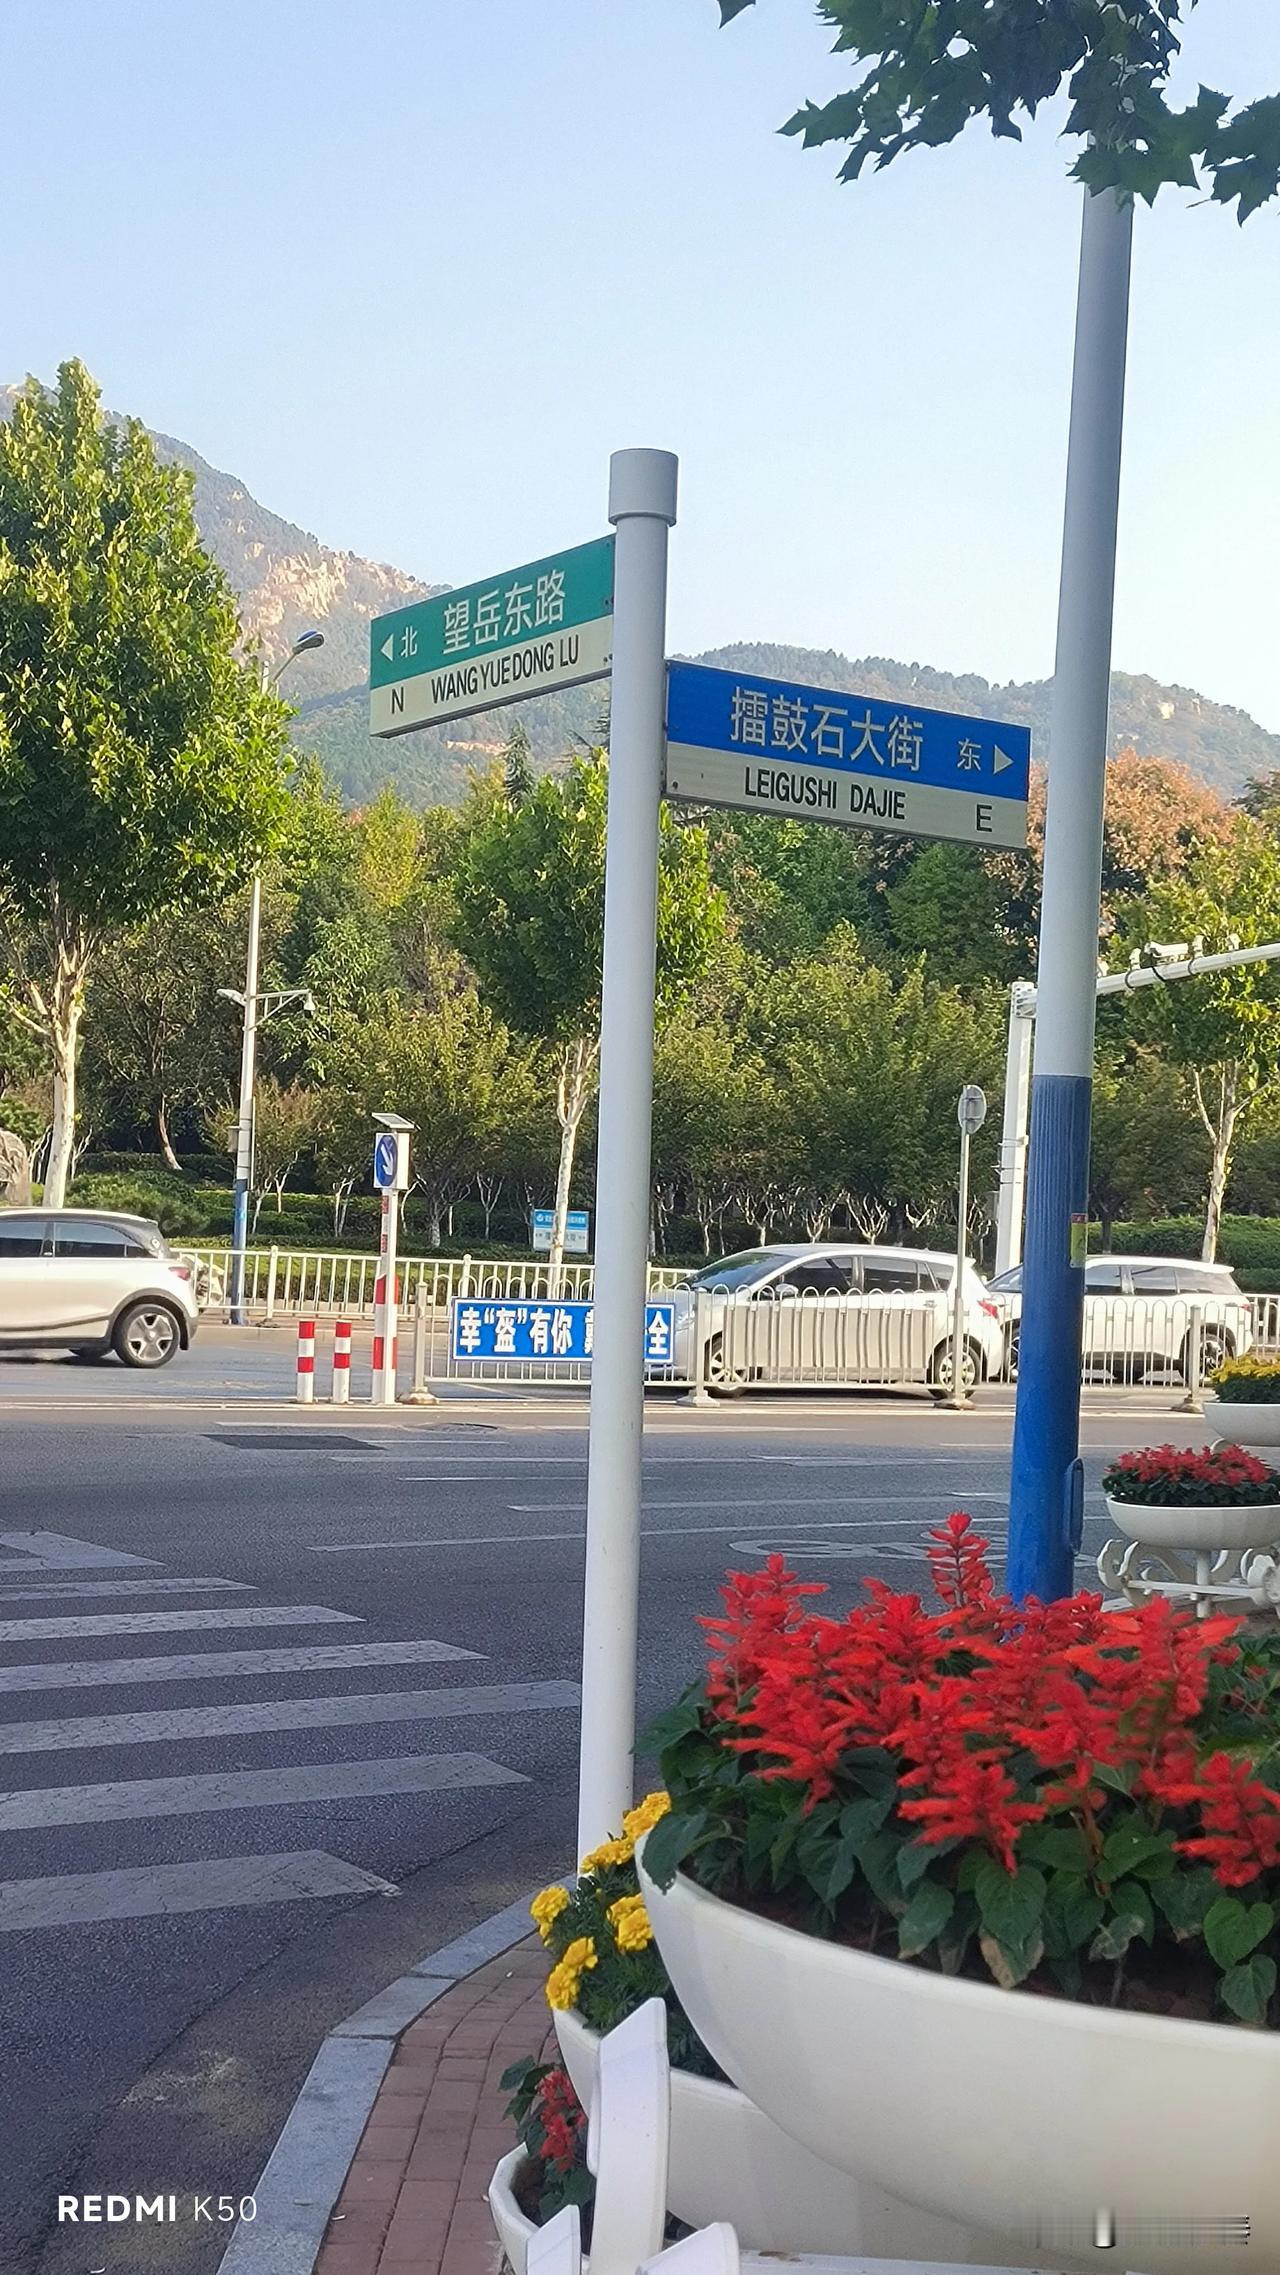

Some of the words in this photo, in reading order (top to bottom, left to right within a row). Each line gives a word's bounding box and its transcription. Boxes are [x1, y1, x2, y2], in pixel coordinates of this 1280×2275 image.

[400, 625, 418, 658] 北
[442, 569, 566, 655] 望岳东路
[391, 686, 405, 714] N
[560, 634, 579, 667] LU
[730, 685, 924, 772] 擂鼓石大街
[957, 738, 982, 771] 东
[745, 766, 838, 809] LEIGUSHI
[850, 785, 906, 820] DAJIE
[976, 804, 993, 832] E
